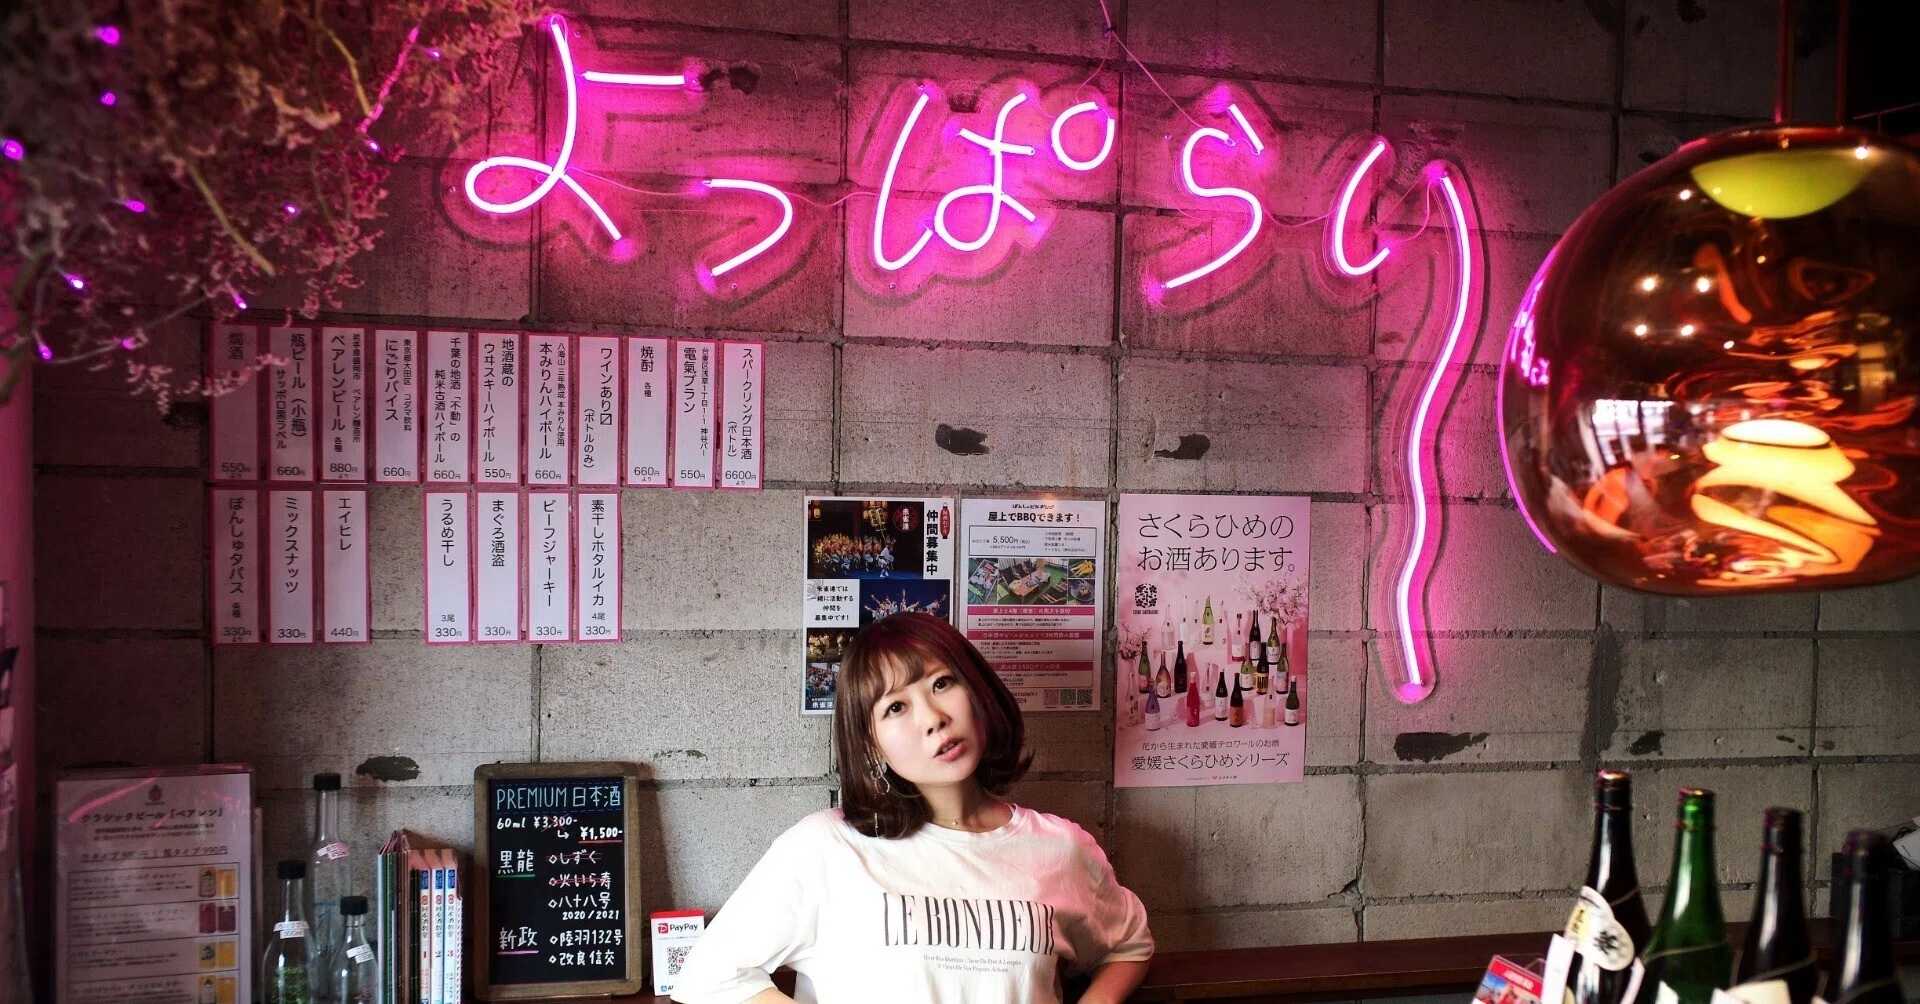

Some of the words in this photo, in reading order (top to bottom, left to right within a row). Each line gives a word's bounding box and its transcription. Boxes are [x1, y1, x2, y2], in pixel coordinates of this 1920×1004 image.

[403, 338, 412, 386] 東京都大田区
[501, 338, 515, 386] 地酒蔵の
[640, 345, 654, 373] 焼酎
[331, 335, 346, 431] ベアレンビール
[385, 338, 399, 421] にごりバイス
[683, 347, 697, 414] 電氣ブラン
[643, 382, 652, 398] 各種
[483, 343, 496, 463] ウヰスキーハイボール
[539, 342, 553, 460] 本みりんハイボール
[740, 348, 753, 461] スパークリング日本酒
[434, 369, 446, 464] 純米古酒ハイボール
[277, 466, 305, 476] 660円
[330, 462, 358, 474] 880円
[383, 466, 411, 477] 660円
[434, 469, 461, 479] 660円
[484, 468, 512, 479] 550円
[535, 469, 561, 480] 660円
[634, 466, 660, 477] 660円
[680, 469, 706, 480] 550円
[725, 470, 756, 480] 6600円
[338, 498, 352, 551] エイヒレ
[441, 499, 455, 567] うるめ干し
[491, 499, 505, 567] まぐろ酒盗
[1138, 513, 1294, 540] さくらひめの
[285, 497, 299, 594] ミックスナッツ
[926, 510, 939, 576] 仲間募集中
[543, 500, 557, 607] ビーフジャーキー
[591, 499, 605, 606] 素干しホタルイカ
[1137, 546, 1296, 573] お酒あります。
[592, 612, 605, 621] 4尾
[823, 604, 842, 612] 仲間を
[441, 613, 455, 623] 3尾
[223, 626, 252, 637] 330円
[277, 628, 306, 639] 330円
[330, 627, 359, 637] 440円
[435, 627, 462, 638] 330円
[485, 626, 511, 636] 330円
[536, 626, 563, 636] 330円
[585, 625, 611, 636] 330円
[1142, 739, 1280, 751] 花から生まれた愛媛テロワールのお酒
[1131, 752, 1290, 771] 愛媛さくらひめシリーズ
[496, 786, 567, 810] PREMIUM
[573, 785, 621, 808] 日本酒
[496, 816, 526, 830] 60ml
[497, 848, 534, 875] 黒龍
[559, 848, 598, 866] しずく
[558, 891, 611, 909] 八十八号
[670, 922, 699, 933] PayPay
[882, 892, 918, 947] LE
[924, 895, 1055, 956] BONHEUR
[499, 925, 538, 950] 新政
[559, 929, 623, 947] 陸羽132号
[559, 949, 615, 967] 改良信交
